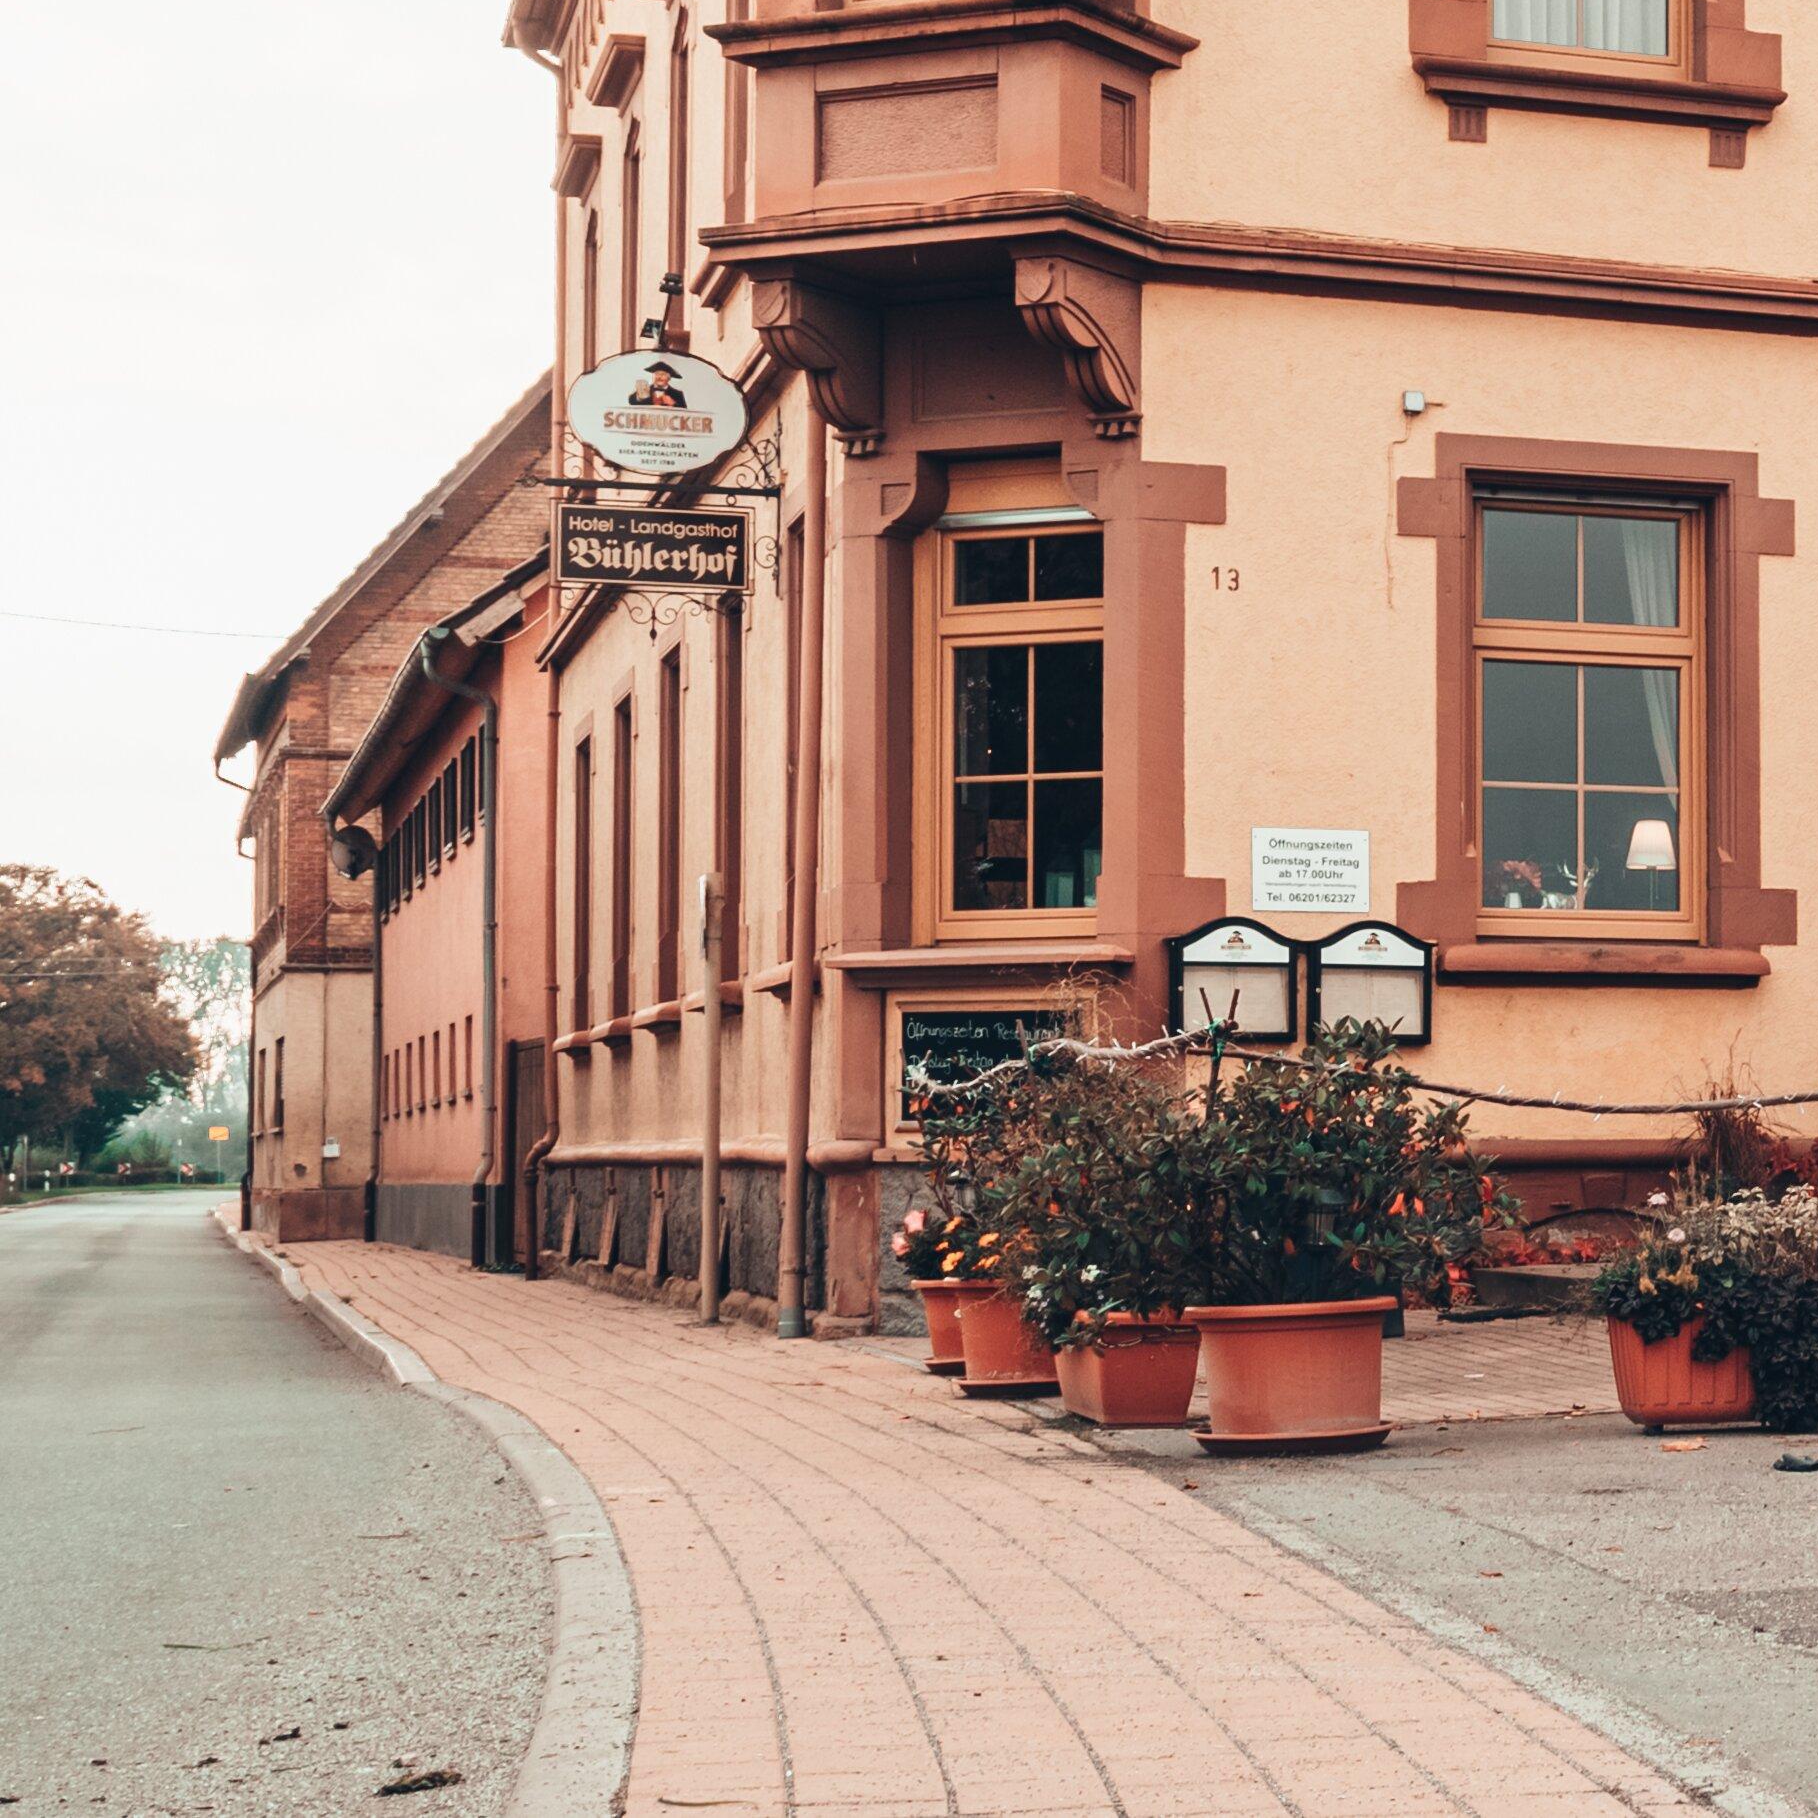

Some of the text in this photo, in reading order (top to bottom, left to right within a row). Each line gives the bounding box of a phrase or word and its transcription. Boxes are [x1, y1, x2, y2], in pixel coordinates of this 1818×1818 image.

[603, 411, 713, 434] SCHMUCKER
[568, 515, 614, 532] Hotel
[630, 518, 738, 540] Landgasthof
[567, 537, 738, 582] Bühlerhof
[1211, 566, 1240, 592] 13
[1268, 837, 1353, 851] Öffnungszeiten
[1262, 855, 1312, 868] Dienstag
[1321, 856, 1360, 870] Freitag
[1278, 869, 1292, 879] ab
[1266, 892, 1356, 903] Tel. 06201/62327
